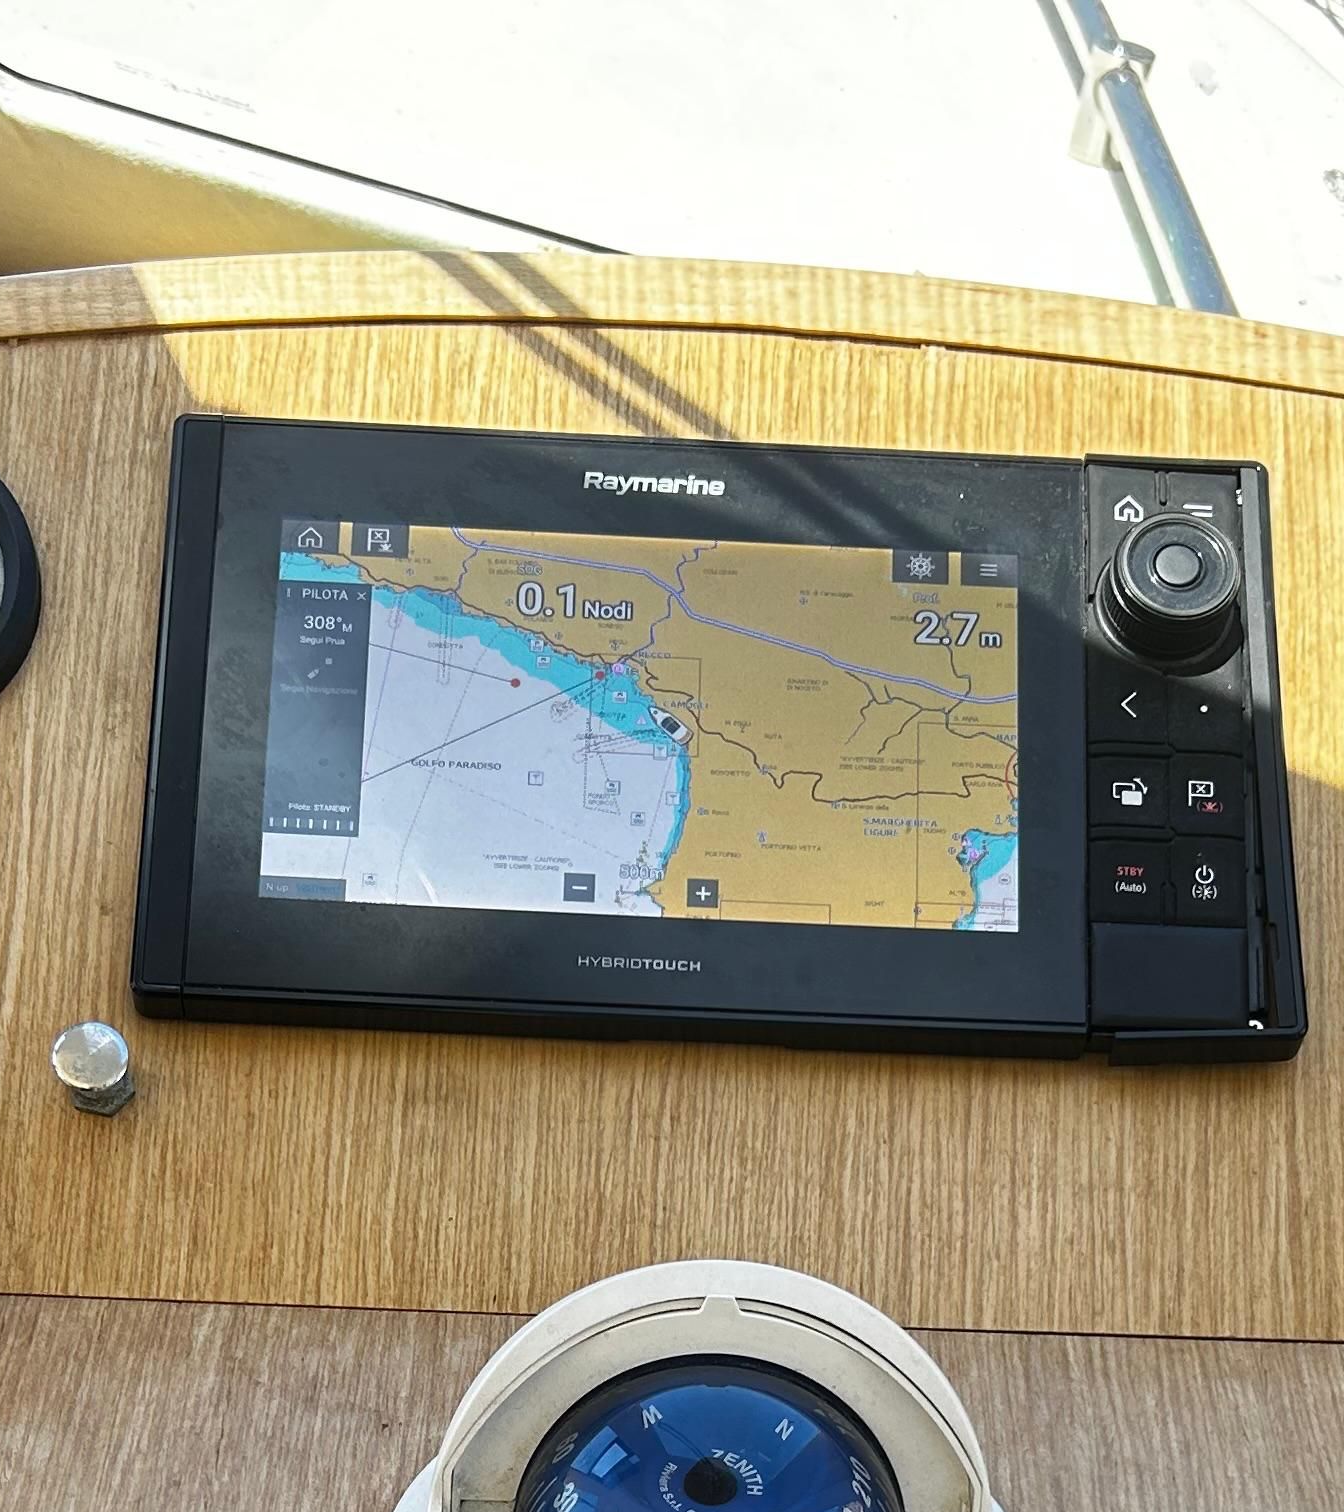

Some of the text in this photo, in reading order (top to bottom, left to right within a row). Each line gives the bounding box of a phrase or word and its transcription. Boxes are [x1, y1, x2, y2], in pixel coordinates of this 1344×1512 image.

[583, 471, 726, 496] Raymarine
[302, 588, 349, 601] PILOTA
[516, 580, 634, 620] 0.1 Nodi
[913, 609, 1002, 648] 2.7 m
[410, 759, 503, 771] GOLFO PARADISO
[1116, 866, 1144, 877] STBY
[1115, 881, 1147, 894] (Auto)
[577, 955, 702, 972] HYBRIDTOUCH
[774, 1418, 795, 1442] N
[711, 1448, 764, 1496] ZENITH
[849, 1456, 872, 1507] 210
